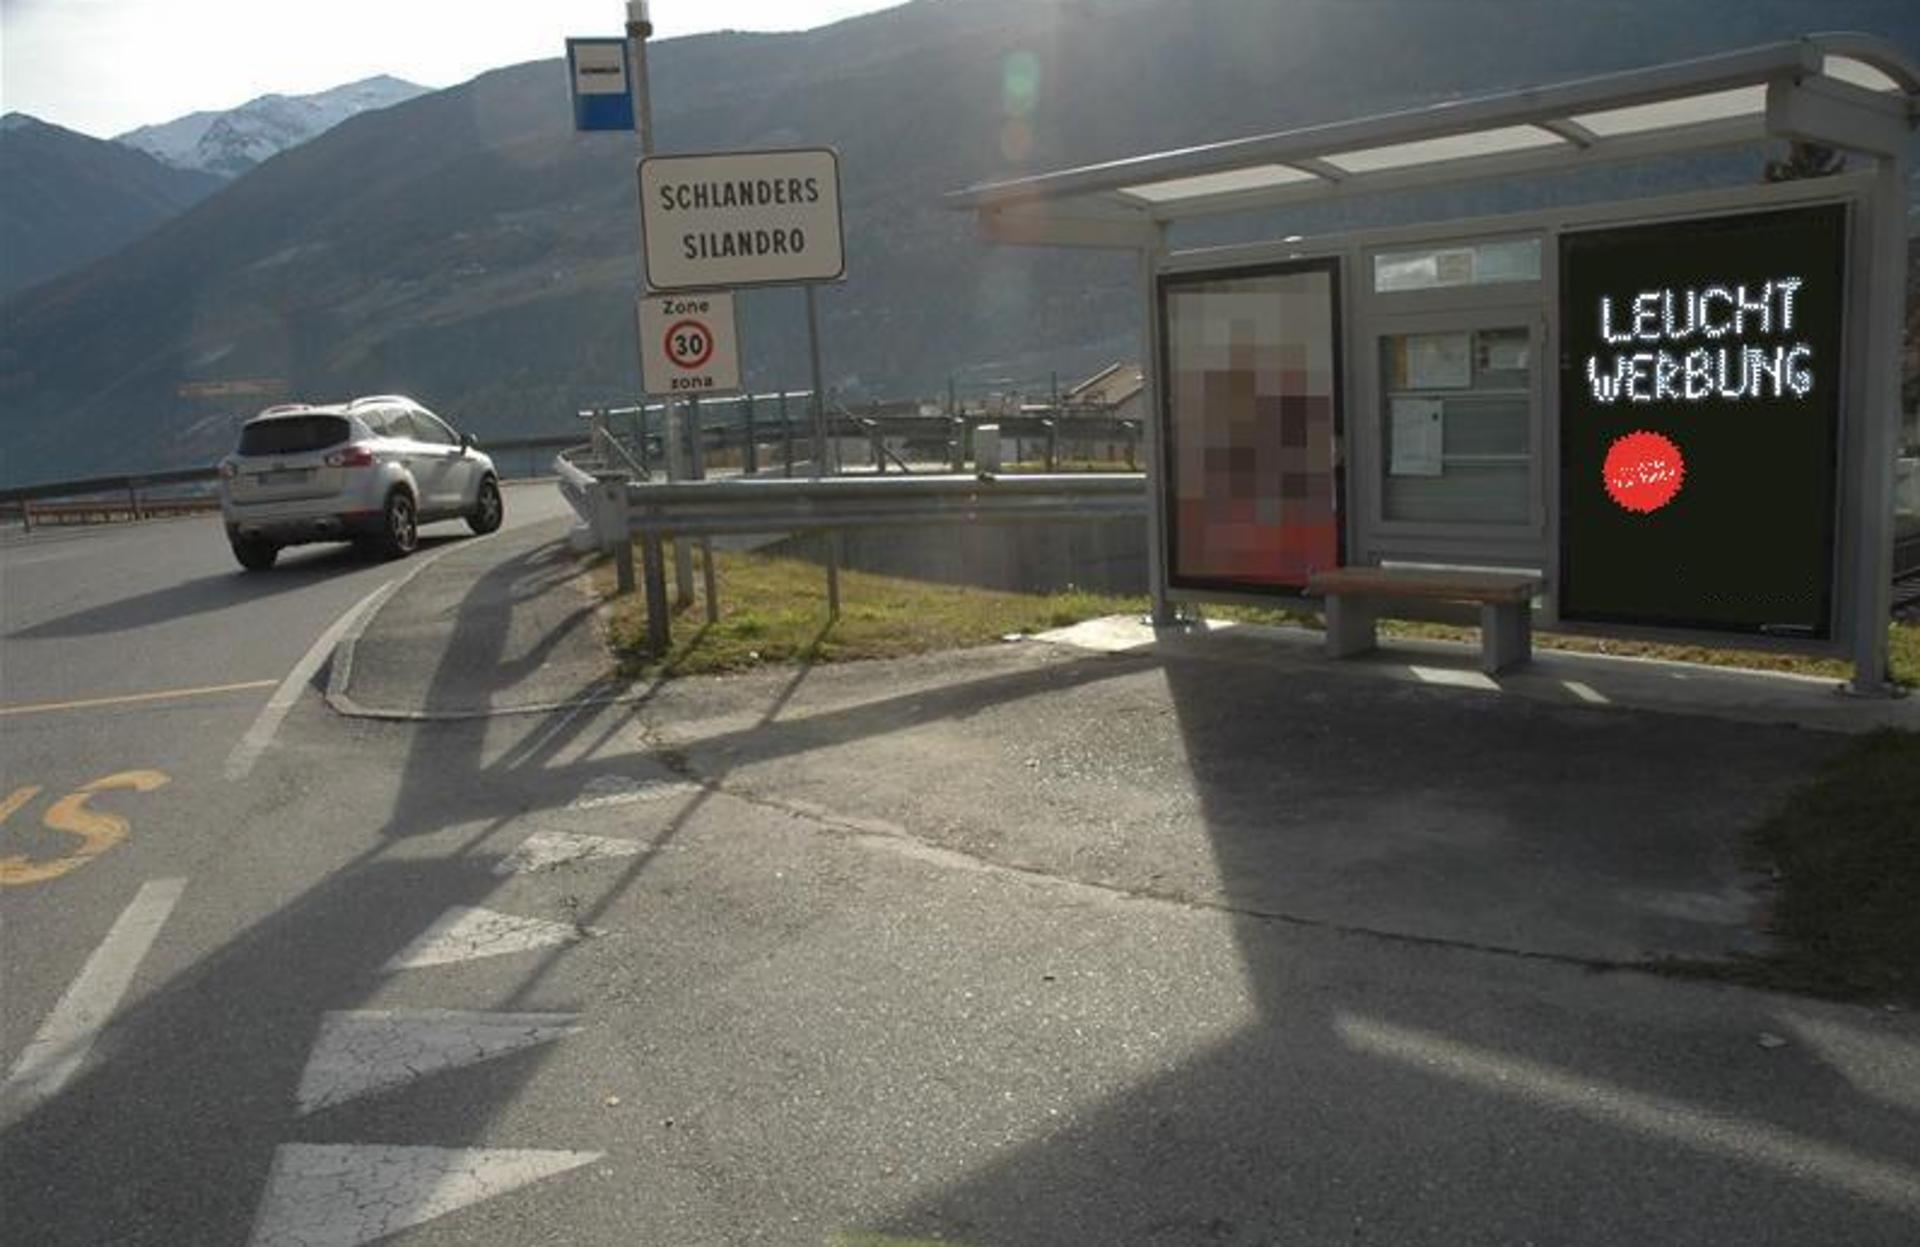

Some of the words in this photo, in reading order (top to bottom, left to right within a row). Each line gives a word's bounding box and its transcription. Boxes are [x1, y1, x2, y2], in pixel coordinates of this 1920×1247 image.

[660, 177, 819, 211] SCHLANDERS
[683, 228, 805, 260] SILANDRO
[662, 300, 710, 315] Zone
[1600, 277, 1802, 343] LEUCHT
[674, 333, 703, 356] 30
[671, 375, 713, 390] zona
[1587, 343, 1812, 401] WERBUNG
